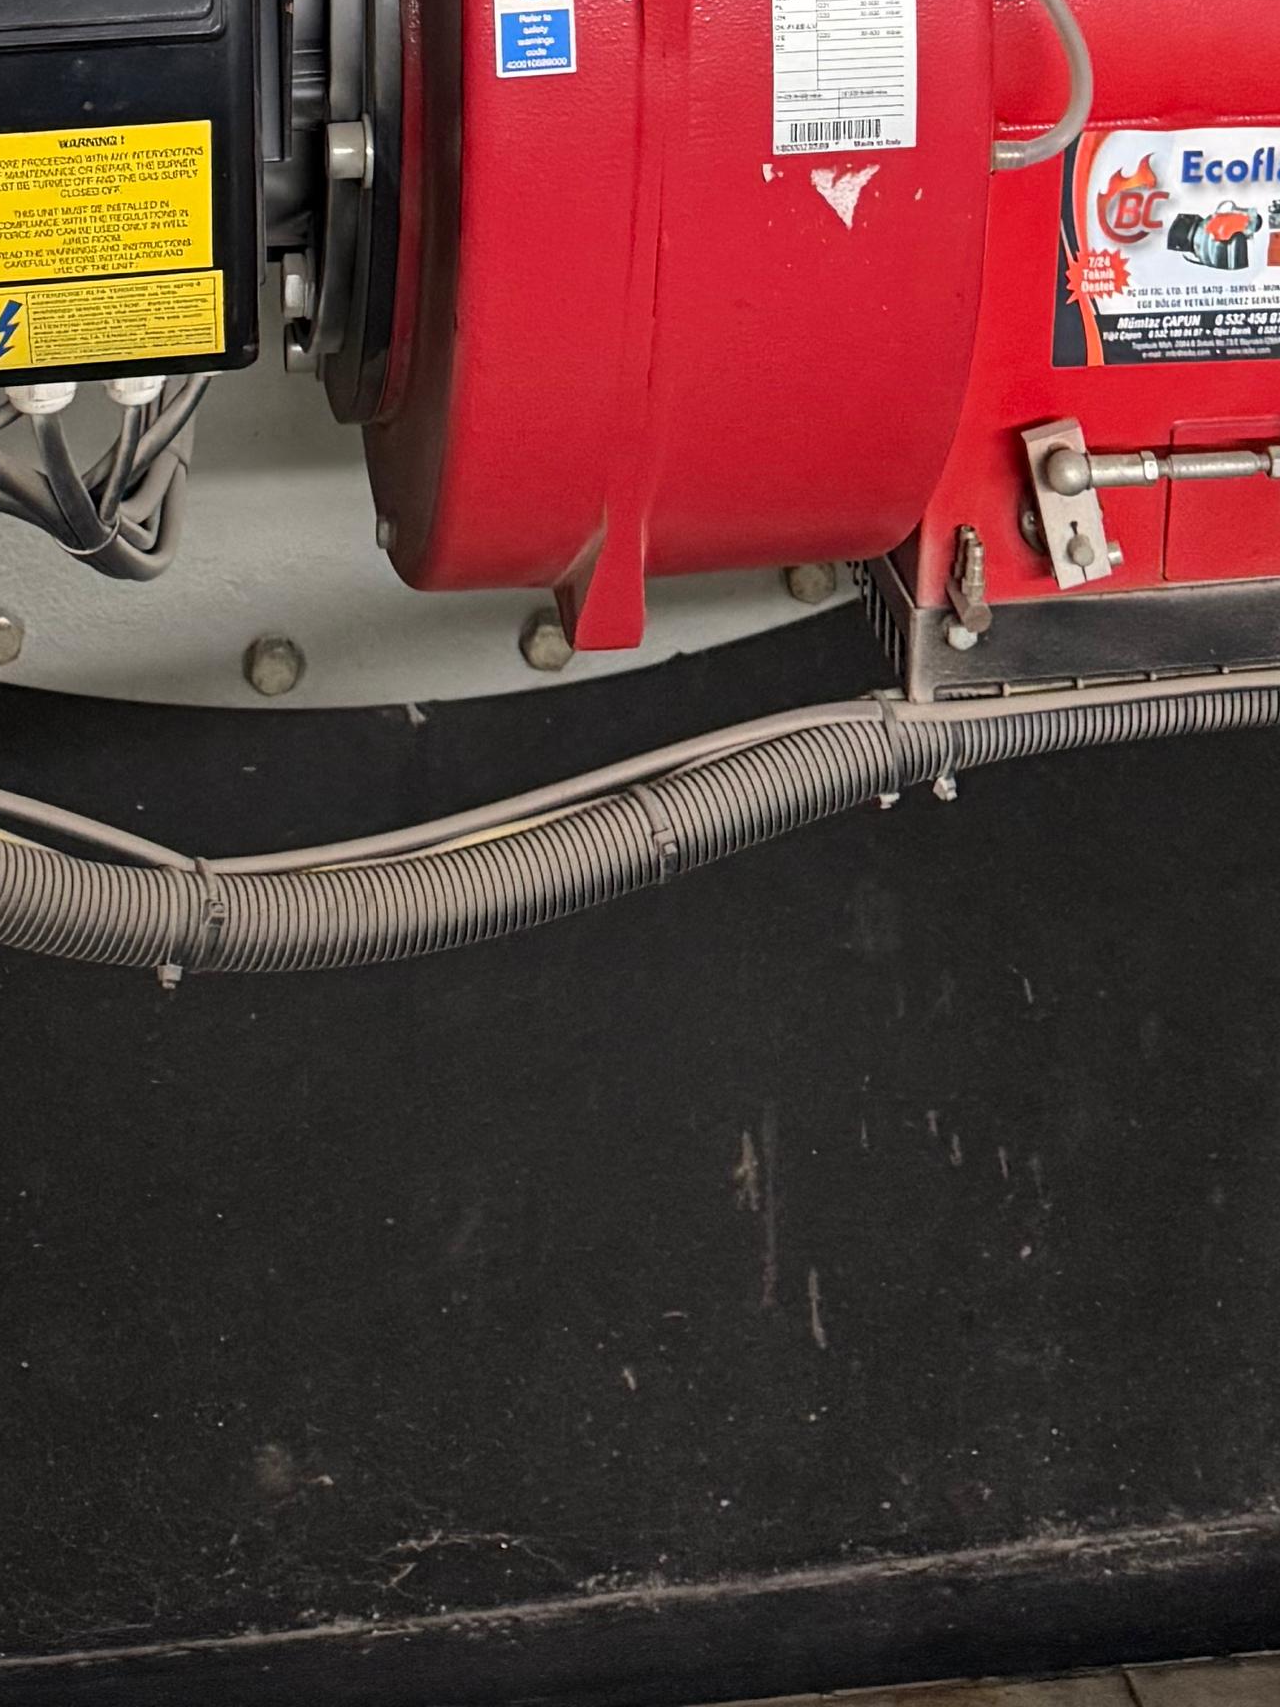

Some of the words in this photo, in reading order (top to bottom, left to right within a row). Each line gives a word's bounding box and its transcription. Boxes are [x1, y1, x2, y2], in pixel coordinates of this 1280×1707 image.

[1114, 191, 1169, 230] BC
[1088, 256, 1111, 268] 7/24
[1083, 269, 1116, 281] Teknik
[1080, 281, 1116, 293] Destek
[1117, 317, 1161, 329] Mümtaz
[1162, 314, 1201, 330] ÇAPUN
[1225, 313, 1246, 326] 532
